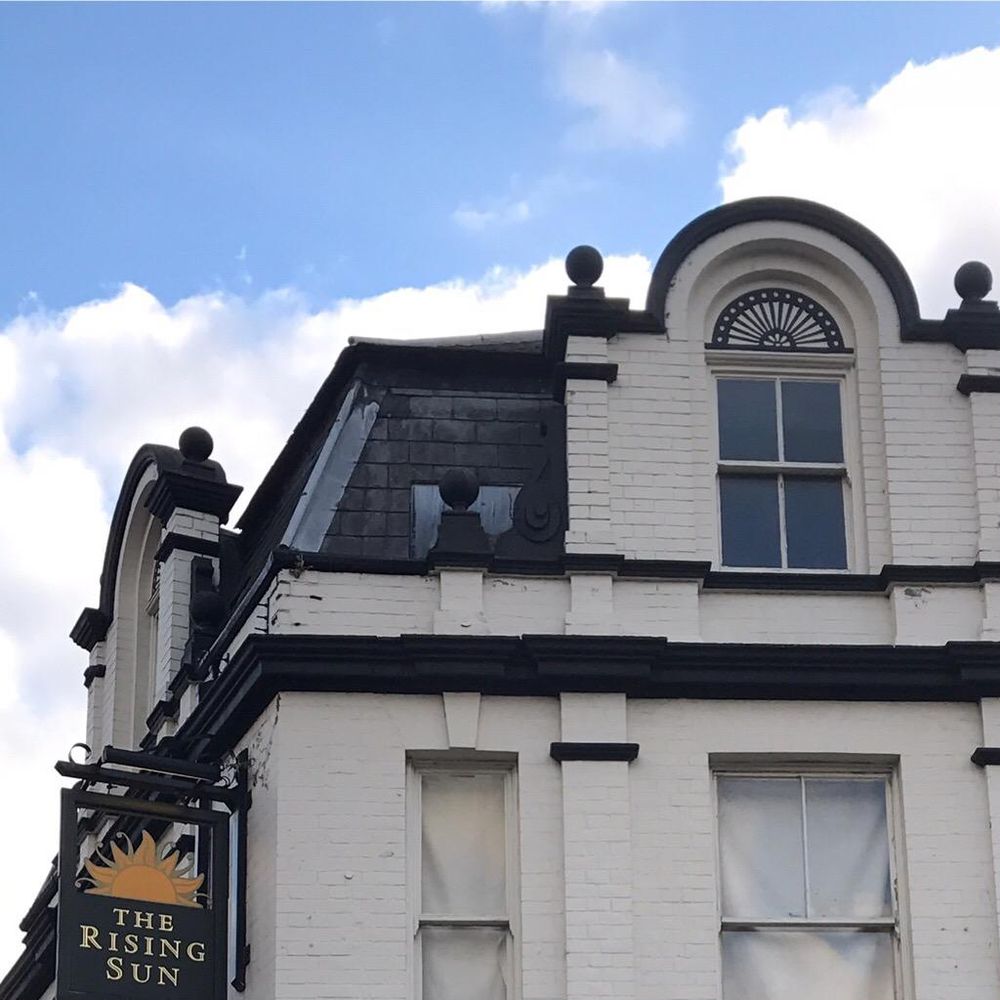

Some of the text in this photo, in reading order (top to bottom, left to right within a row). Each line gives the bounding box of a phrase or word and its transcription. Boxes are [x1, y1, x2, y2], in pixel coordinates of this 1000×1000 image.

[113, 908, 175, 932] THE
[80, 925, 205, 962] RISING
[106, 957, 180, 987] SUN
